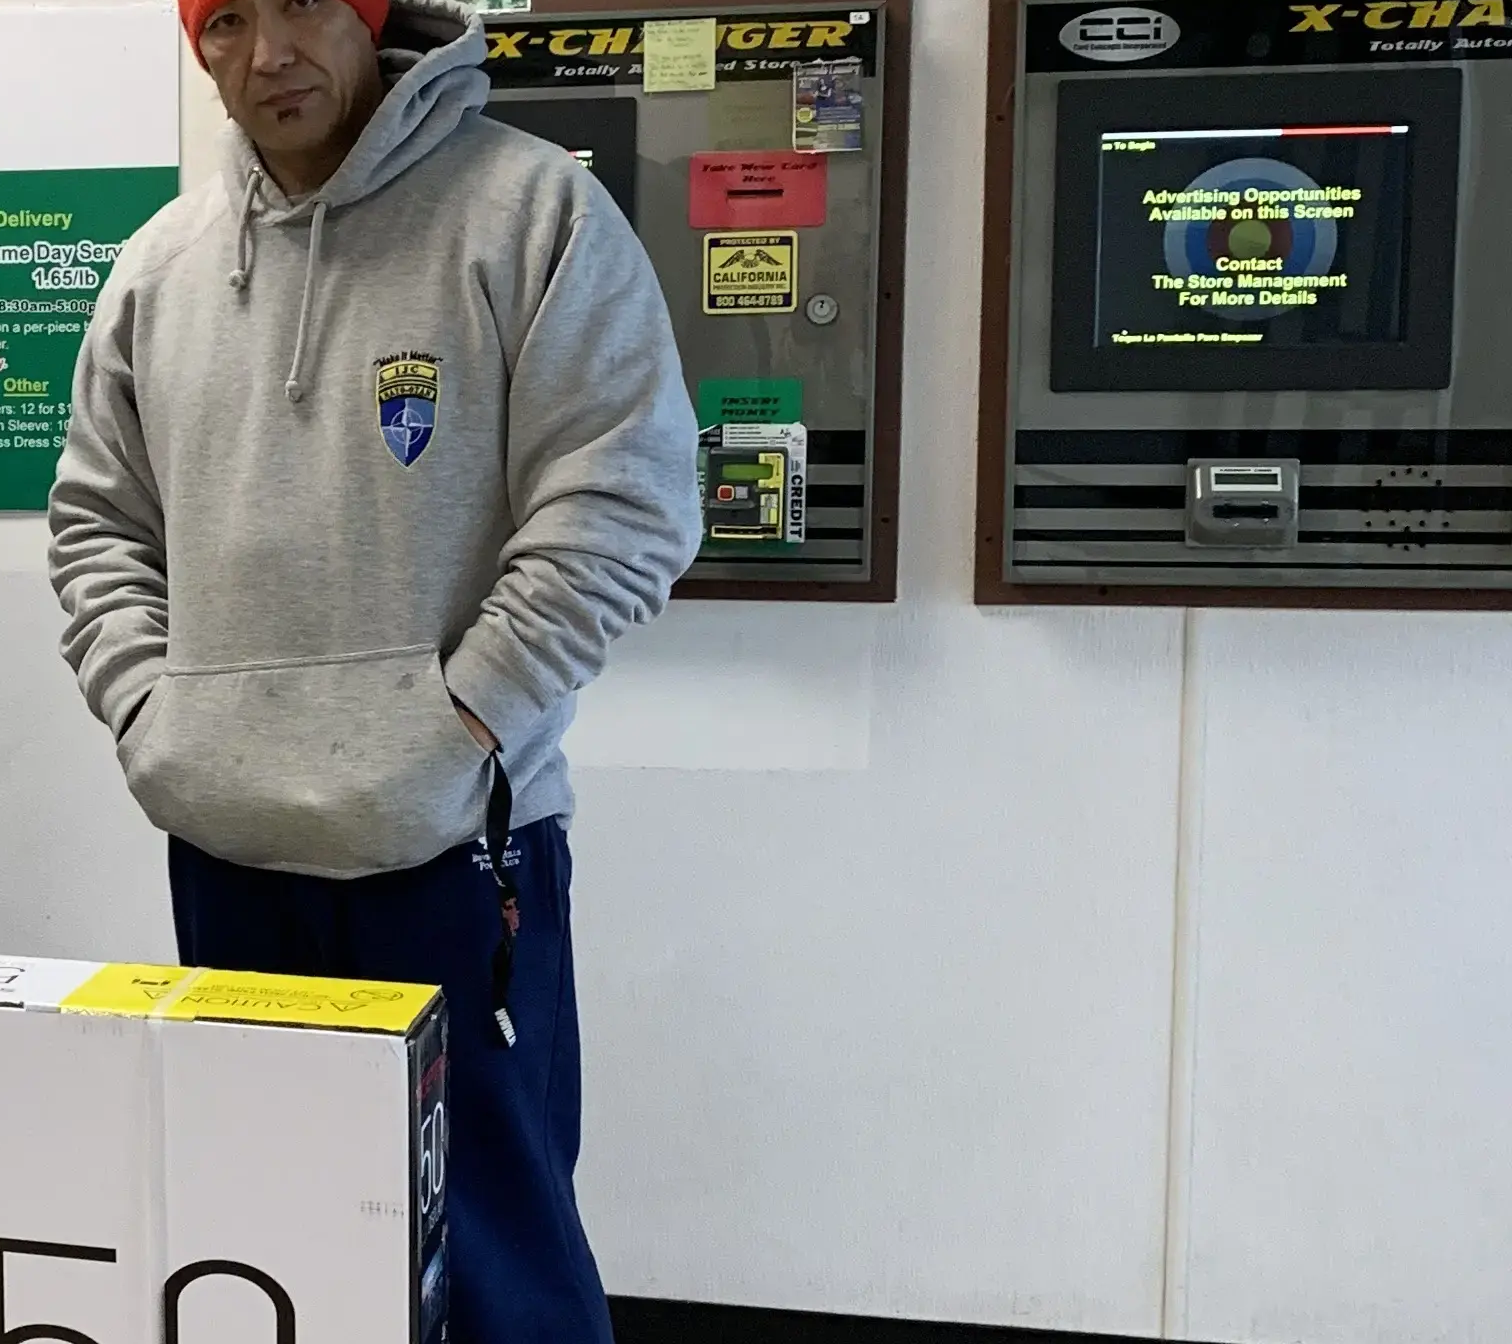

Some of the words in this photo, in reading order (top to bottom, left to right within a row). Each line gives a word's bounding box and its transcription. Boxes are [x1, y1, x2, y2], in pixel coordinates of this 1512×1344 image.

[1369, 39, 1443, 52] Totally
[554, 63, 620, 77] Totally
[701, 164, 736, 173] Take
[740, 163, 776, 172] New
[781, 162, 818, 172] Card
[742, 175, 776, 184] Here
[1143, 189, 1240, 205] Advertising
[1244, 187, 1361, 205] Opportunities
[1149, 206, 1227, 221] Available
[1231, 208, 1253, 219] on
[1257, 205, 1289, 219] this
[1294, 205, 1353, 219] Screen
[35, 242, 74, 266] Day
[1216, 257, 1283, 271] Contact
[33, 267, 99, 289] 1.65/lb
[713, 271, 787, 283] CALIFORNIA
[1152, 275, 1184, 289] The
[1188, 274, 1233, 289] Store
[1238, 274, 1347, 290] Management
[1179, 292, 1209, 305] For
[1212, 291, 1255, 305] More
[1259, 290, 1317, 305] Details
[4, 378, 49, 392] Other
[790, 474, 804, 539] CREDIT
[421, 1101, 445, 1214] 50
